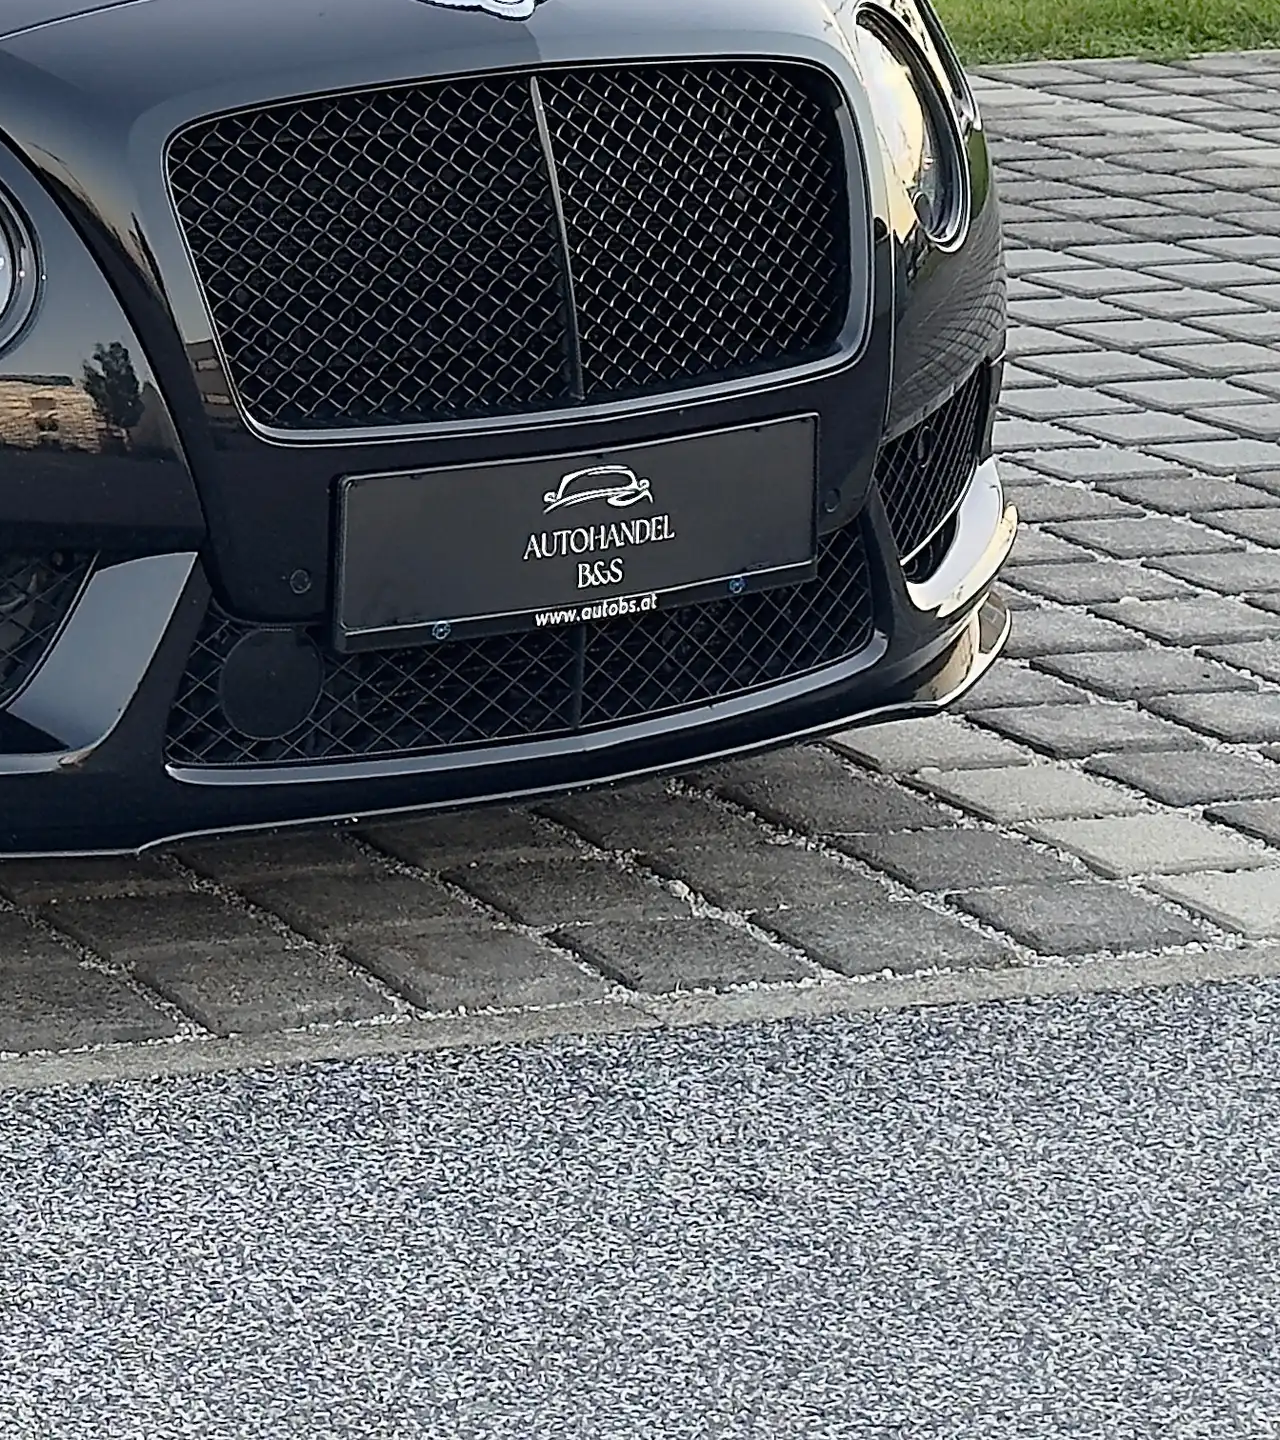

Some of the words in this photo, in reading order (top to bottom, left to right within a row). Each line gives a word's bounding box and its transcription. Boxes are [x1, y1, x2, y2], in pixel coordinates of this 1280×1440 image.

[522, 513, 676, 561] AUTOHANDEL
[576, 557, 624, 589] B&S
[534, 592, 658, 627] www.autobs.at
